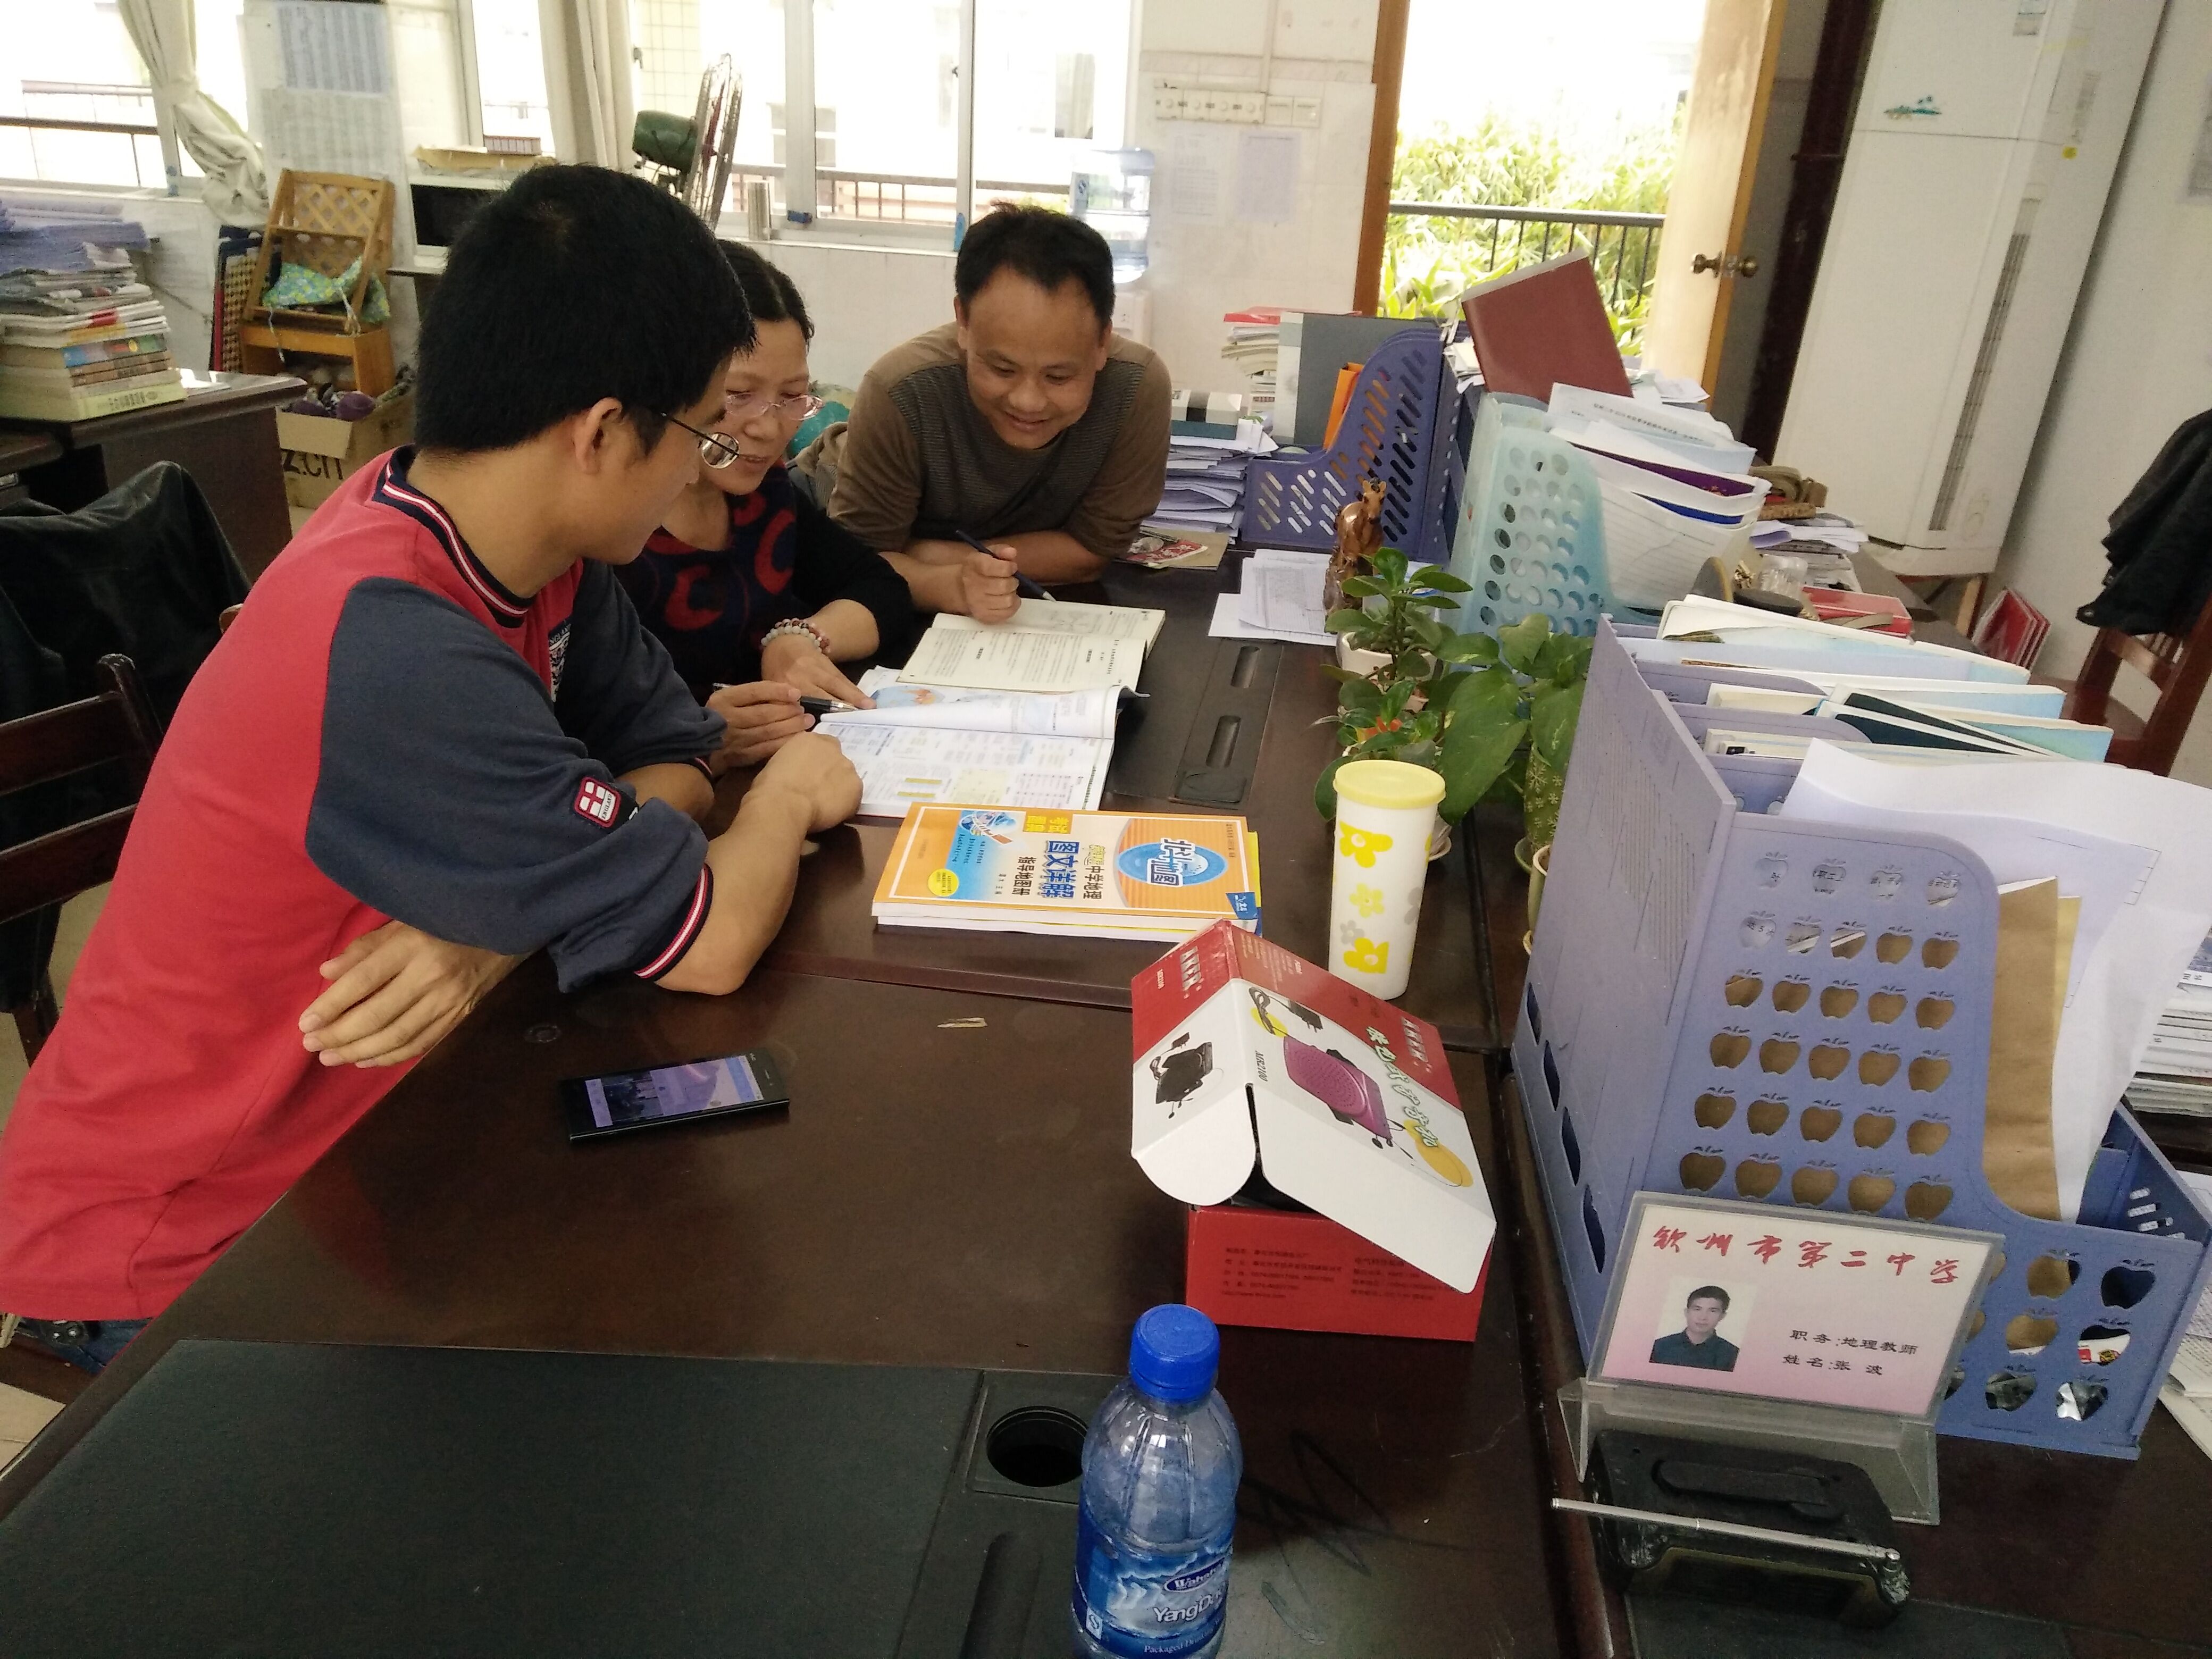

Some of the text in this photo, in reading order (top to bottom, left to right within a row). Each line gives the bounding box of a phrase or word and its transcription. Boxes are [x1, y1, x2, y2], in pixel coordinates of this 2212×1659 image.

[601, 794, 613, 819] ENGLAND
[1012, 857, 1036, 895] 指导地图册
[1040, 841, 1079, 899] 图文详解
[1083, 866, 1104, 899] 中学地理
[1180, 946, 1202, 991] AKER
[1253, 1050, 1268, 1082] MR2100
[1652, 1225, 1960, 1285] 钦州市第二中学
